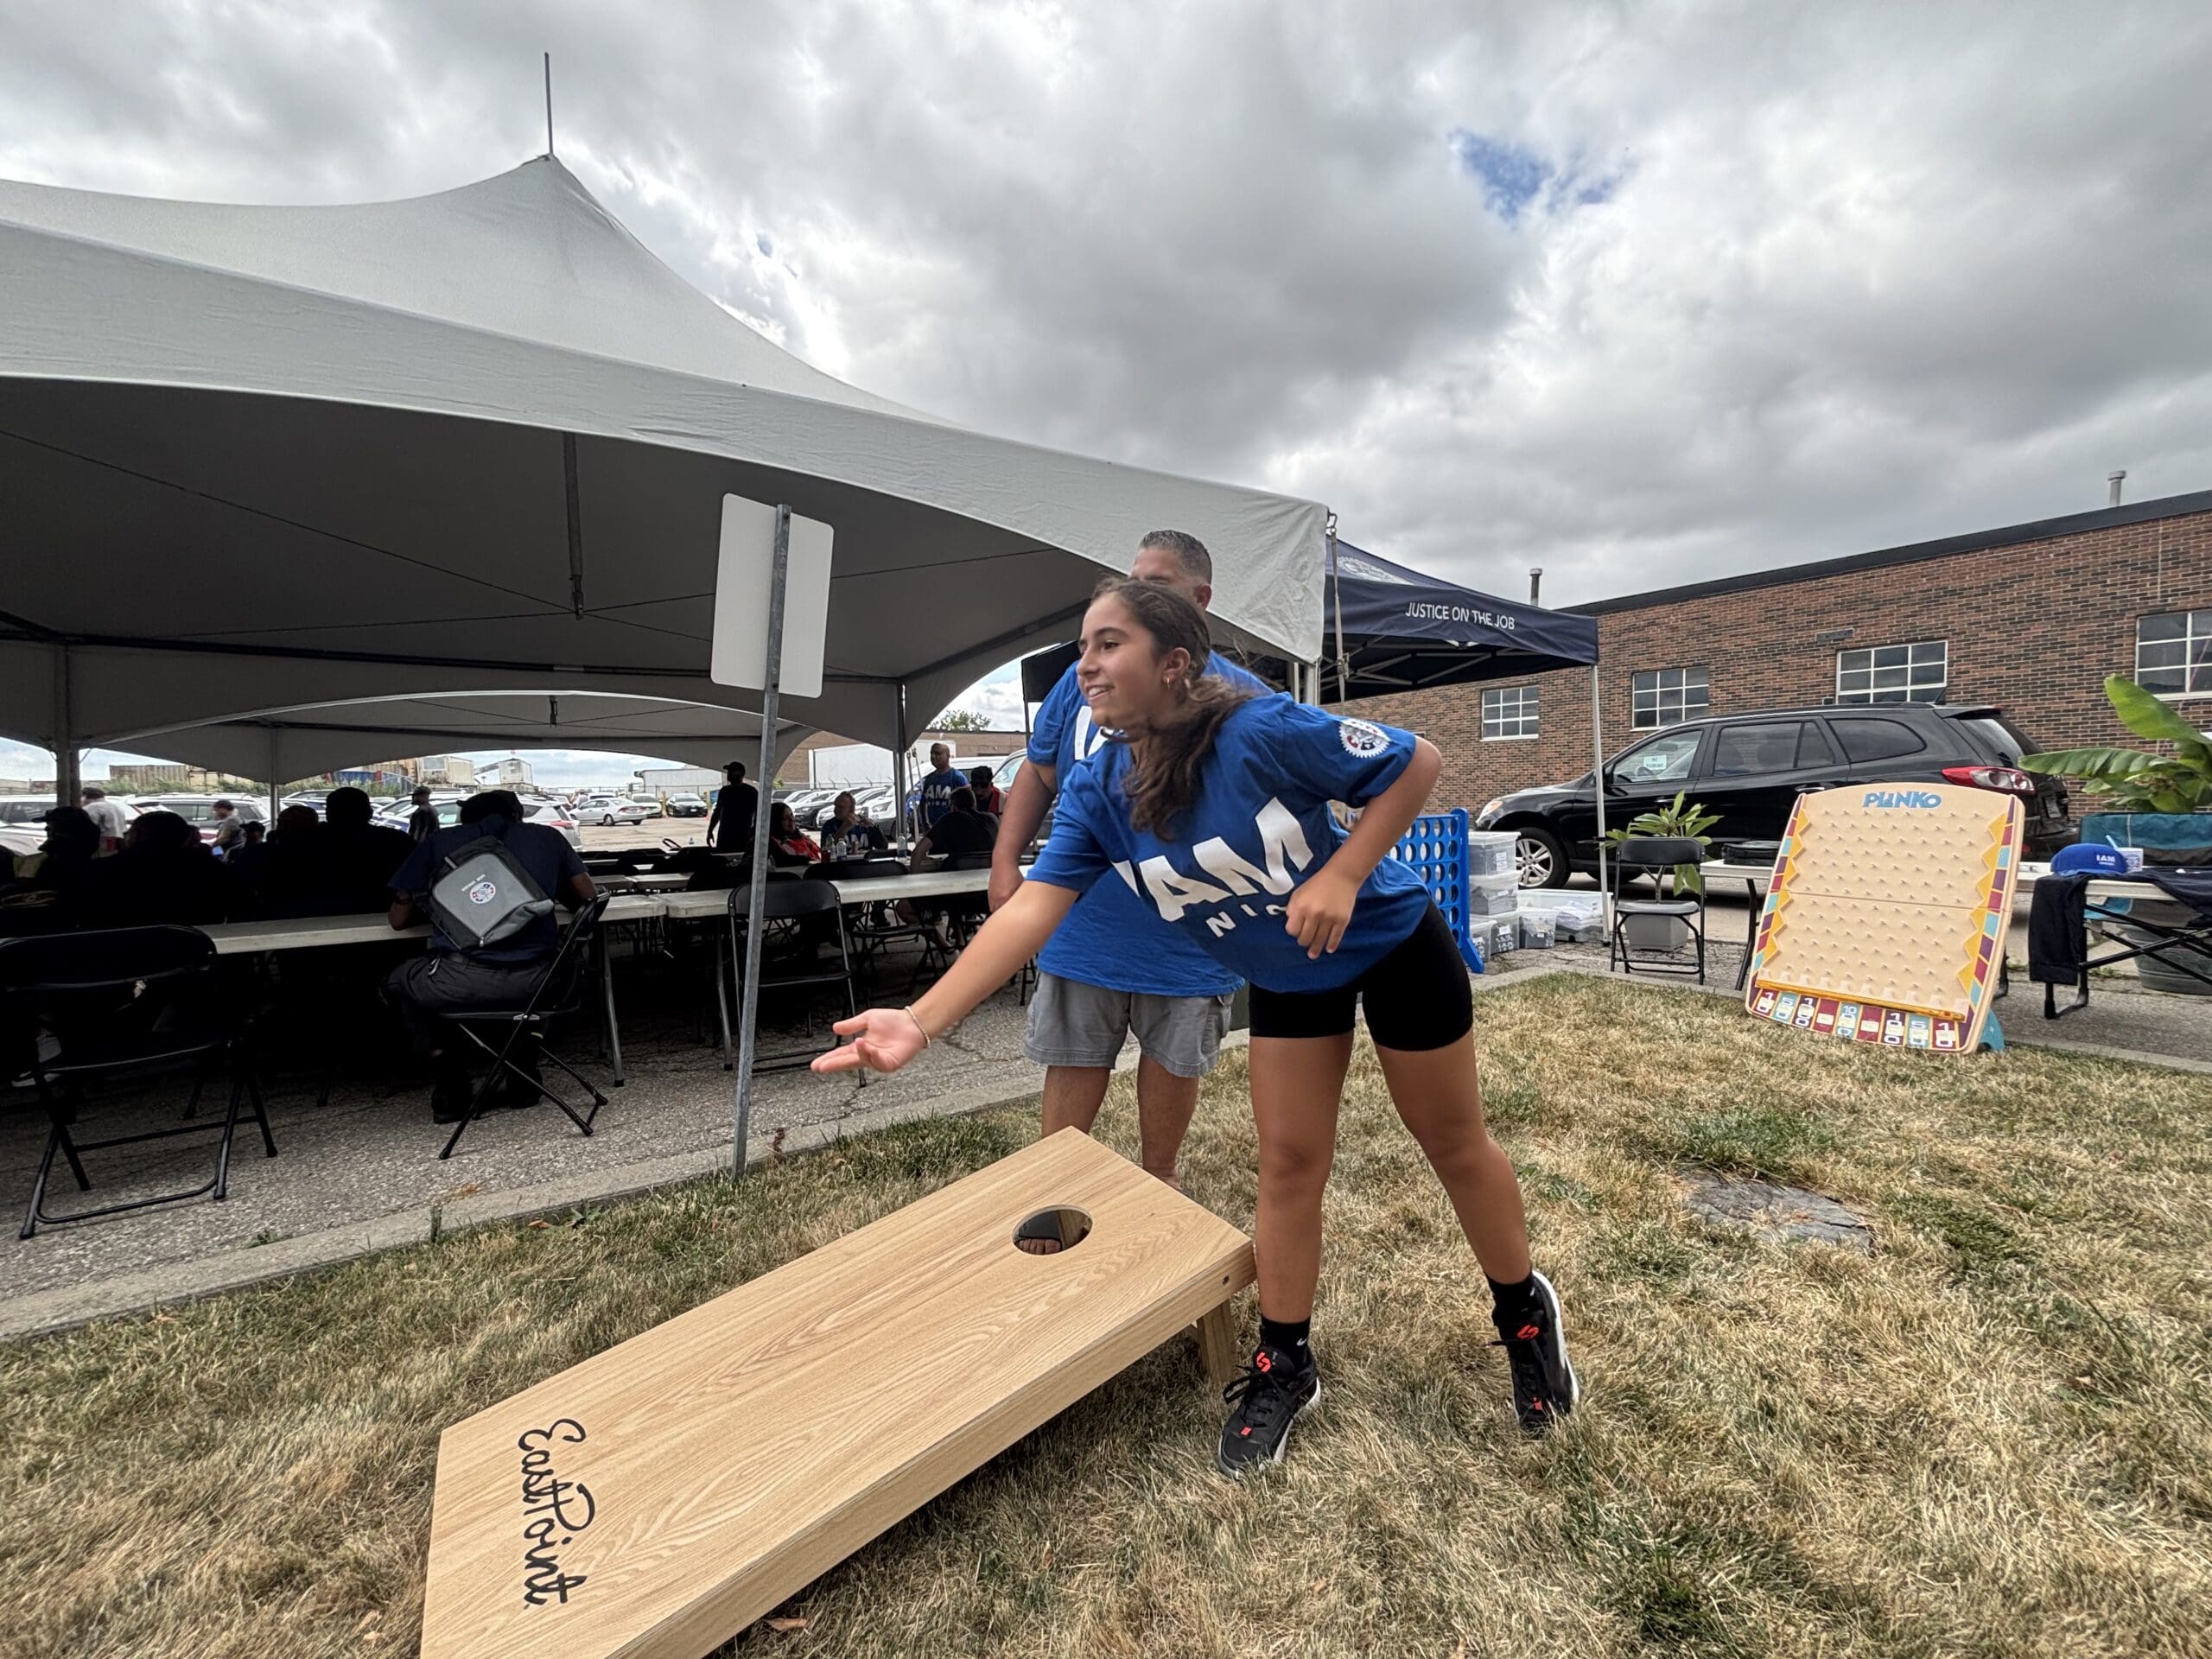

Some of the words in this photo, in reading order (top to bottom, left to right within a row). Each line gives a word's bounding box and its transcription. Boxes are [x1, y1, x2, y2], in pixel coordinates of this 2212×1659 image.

[1405, 602, 1449, 620] JUSTICE
[1452, 607, 1469, 622] ON
[1471, 610, 1493, 626] THE
[1495, 615, 1515, 630] JOB
